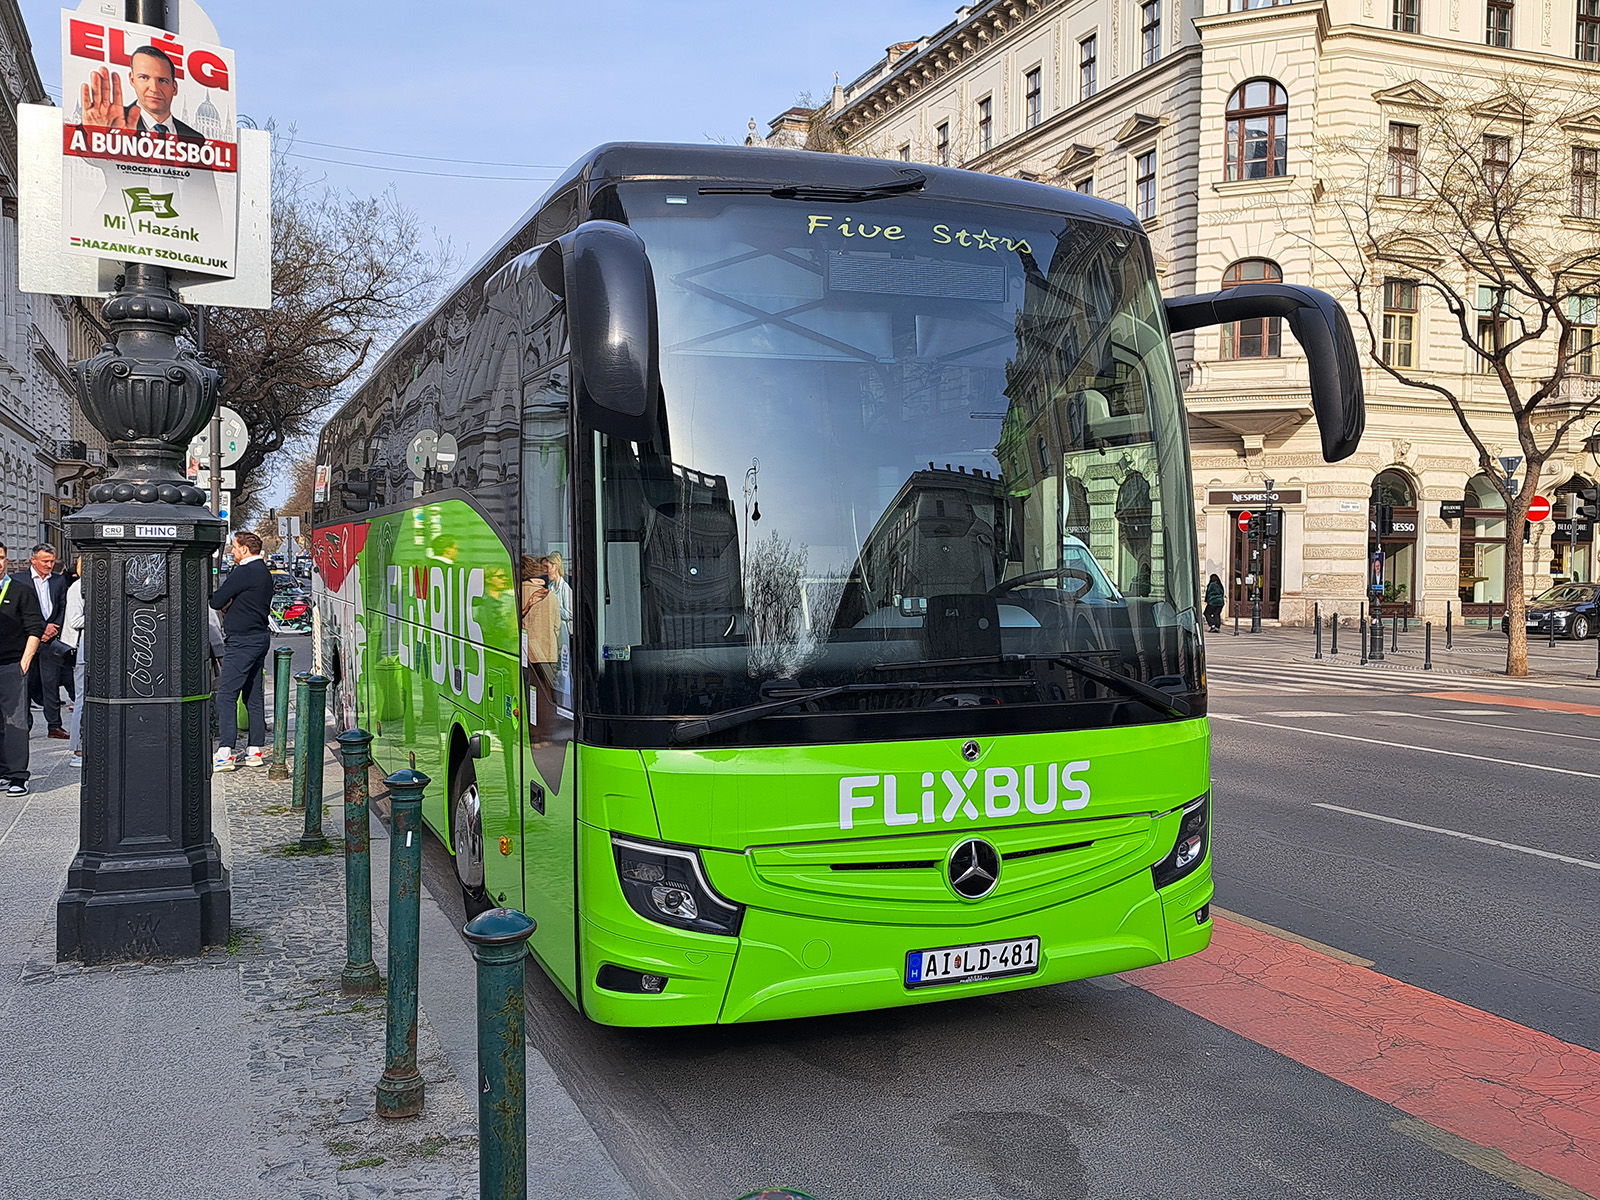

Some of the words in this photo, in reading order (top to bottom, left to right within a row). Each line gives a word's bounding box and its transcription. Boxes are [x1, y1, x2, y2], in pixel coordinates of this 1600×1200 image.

[70, 18, 229, 91] ELÉG
[70, 130, 87, 151] A
[92, 128, 231, 167] BŰNÖZÉSBŐL!
[115, 163, 161, 174] TOROCZKAI
[163, 167, 190, 178] LÁSZLÓ
[103, 213, 126, 230] Mi
[138, 218, 200, 243] Hazánk
[807, 215, 905, 240] Five
[1231, 492, 1279, 502] NESPRESSO
[137, 526, 176, 536] THINC
[1369, 520, 1415, 532] NRESSO
[911, 969, 919, 978] H
[925, 952, 951, 977] AI
[963, 942, 1034, 972] LD-481
